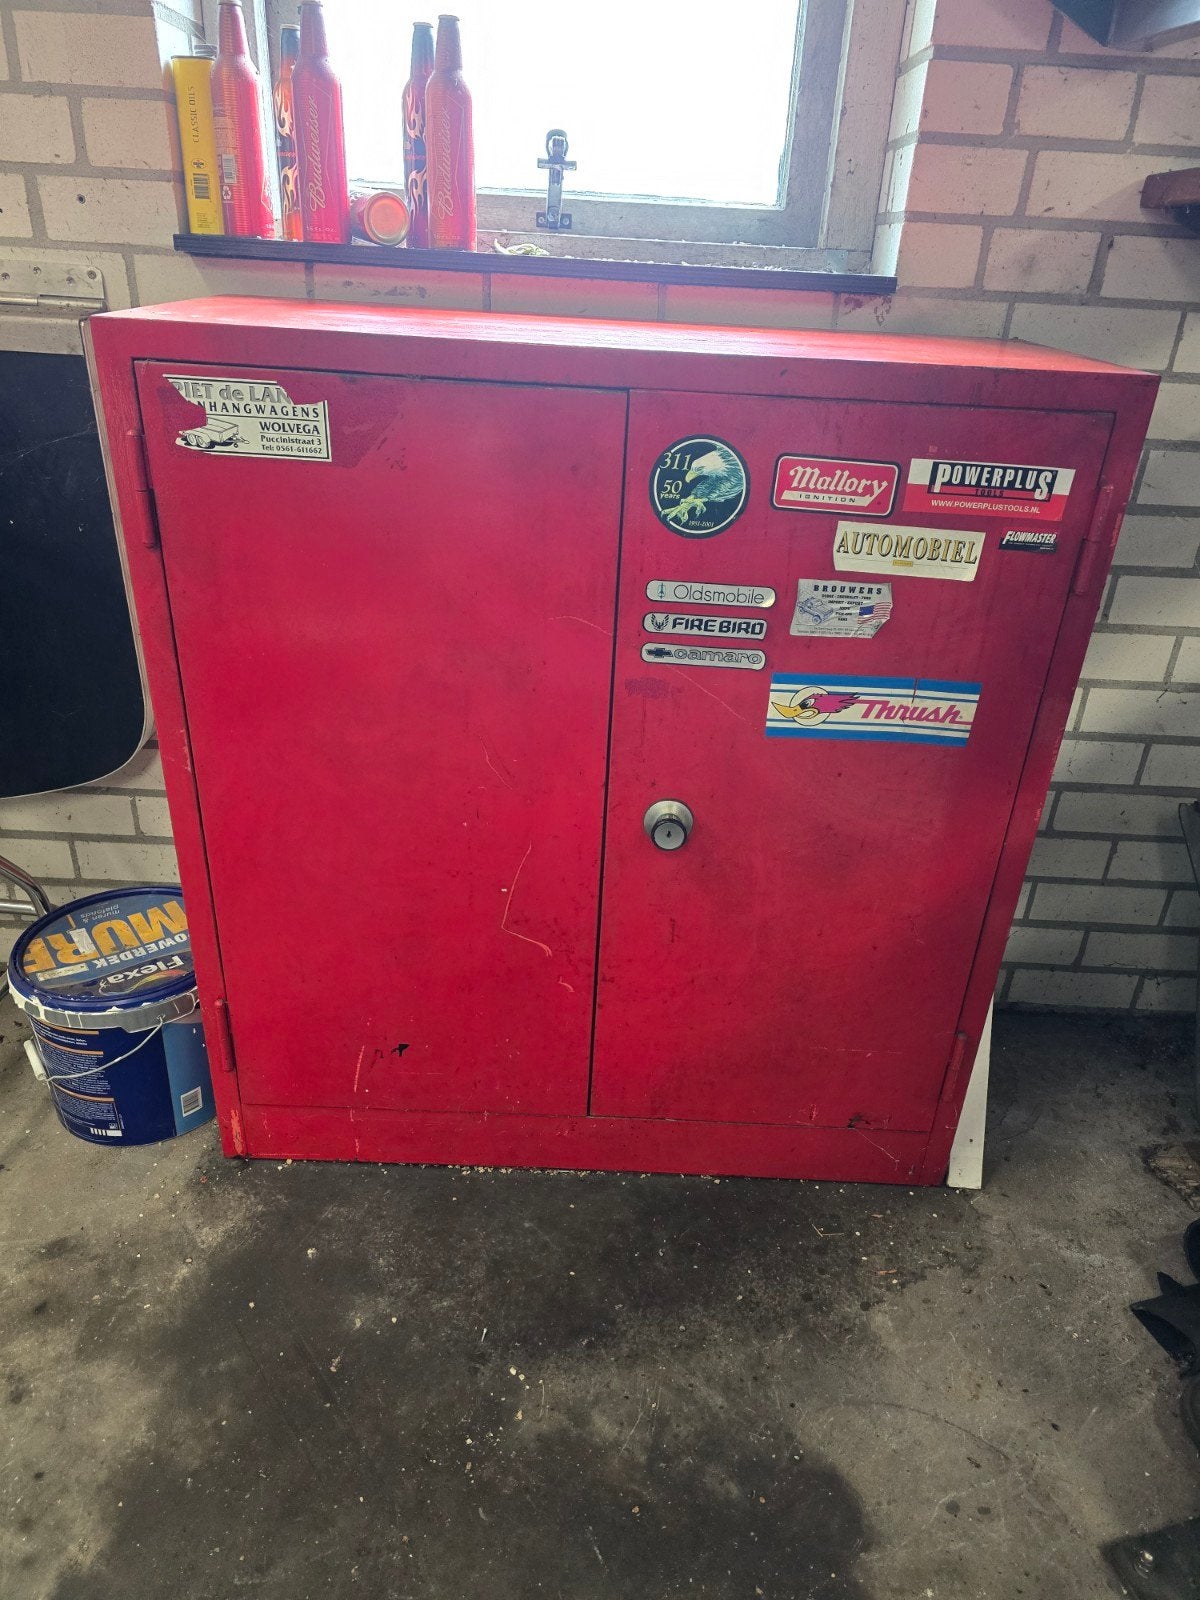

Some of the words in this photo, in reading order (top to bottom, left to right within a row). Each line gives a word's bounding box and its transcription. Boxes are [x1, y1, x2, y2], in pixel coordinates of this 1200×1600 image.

[188, 85, 197, 105] OILS
[190, 107, 200, 143] CLASSIC
[309, 95, 326, 212] Budweiser
[436, 106, 455, 220] Budweiser
[219, 384, 245, 402] de
[258, 421, 321, 436] WOLVEGA
[260, 434, 315, 446] Puccinistraat
[316, 437, 322, 446] 3
[261, 444, 275, 452] Tel:
[659, 451, 692, 471] 311
[660, 479, 683, 495] 50
[789, 465, 889, 498] Mallory
[933, 463, 1053, 501] POWERPLUS
[659, 492, 681, 500] years
[799, 493, 856, 504] IGNITION
[974, 488, 1005, 498] TOOLS
[931, 499, 1041, 514] WWW.POWERPLUSTOOLS.NL
[836, 530, 978, 565] AUTOMOBIEL
[1001, 530, 1057, 545] FLOWMASTER
[673, 584, 765, 605] Oldsmobile
[813, 584, 882, 595] BROUWERS
[671, 616, 765, 636] FIREBIRD
[673, 648, 763, 665] camaro
[855, 699, 974, 726] Thrush
[92, 932, 190, 969] OWERDEK
[106, 956, 185, 984] Flexa
